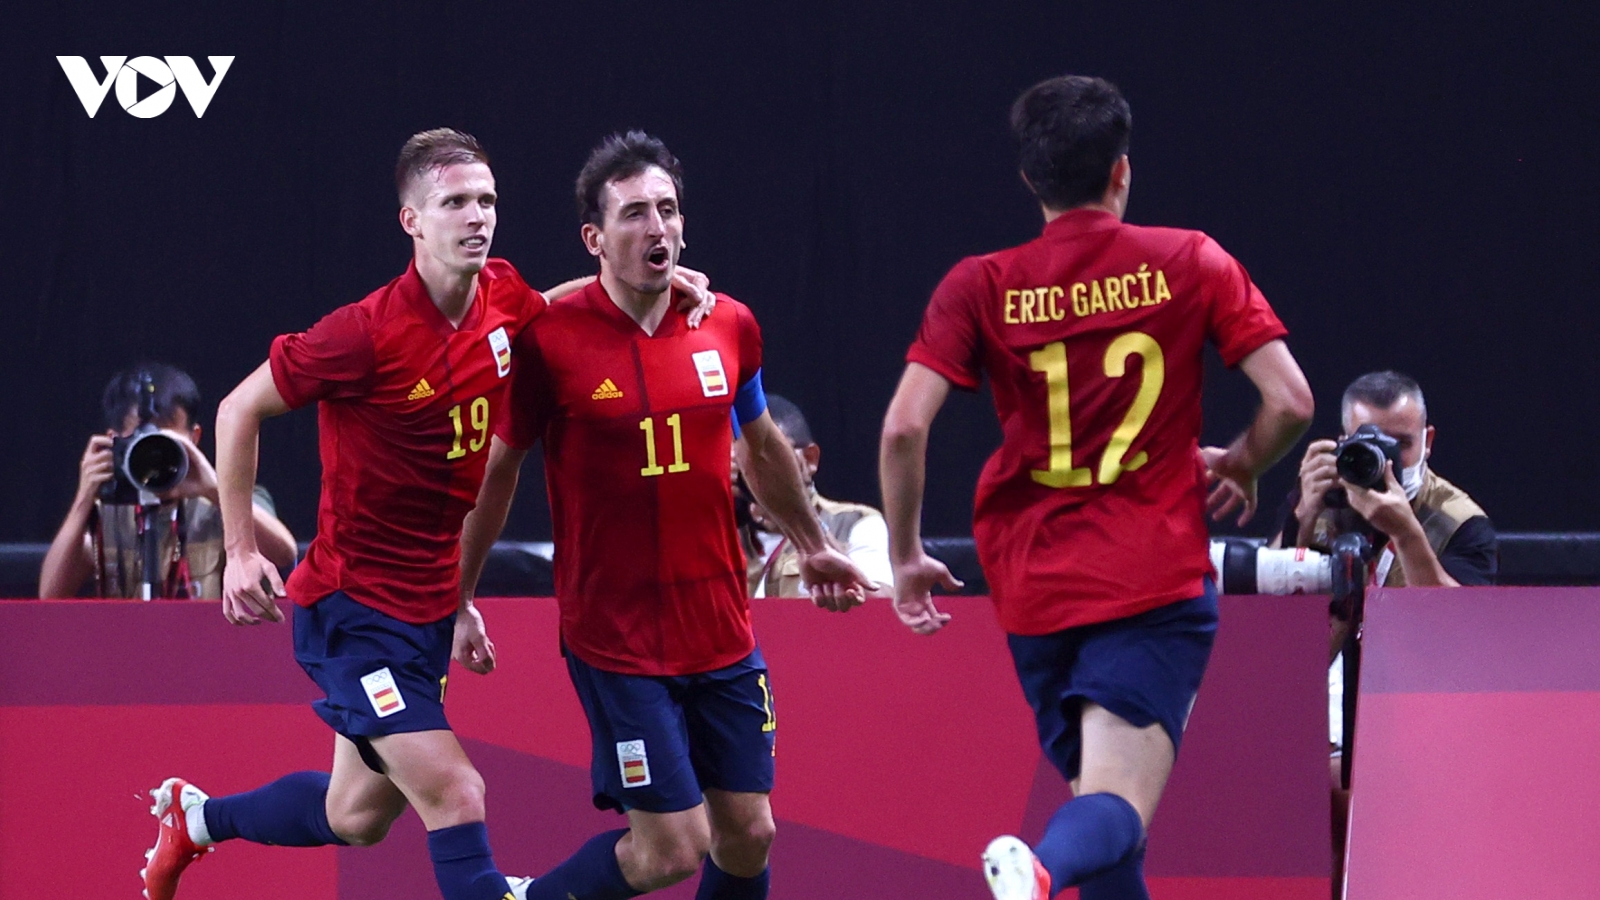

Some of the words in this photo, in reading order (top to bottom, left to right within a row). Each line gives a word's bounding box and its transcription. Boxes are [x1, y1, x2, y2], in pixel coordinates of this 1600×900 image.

[1003, 286, 1066, 325] ERIC
[1071, 263, 1172, 317] GARCÍA
[407, 388, 435, 401] adidas
[591, 390, 624, 400] adidas
[1029, 331, 1165, 489] 12
[446, 396, 489, 460] 19
[639, 413, 691, 477] 11
